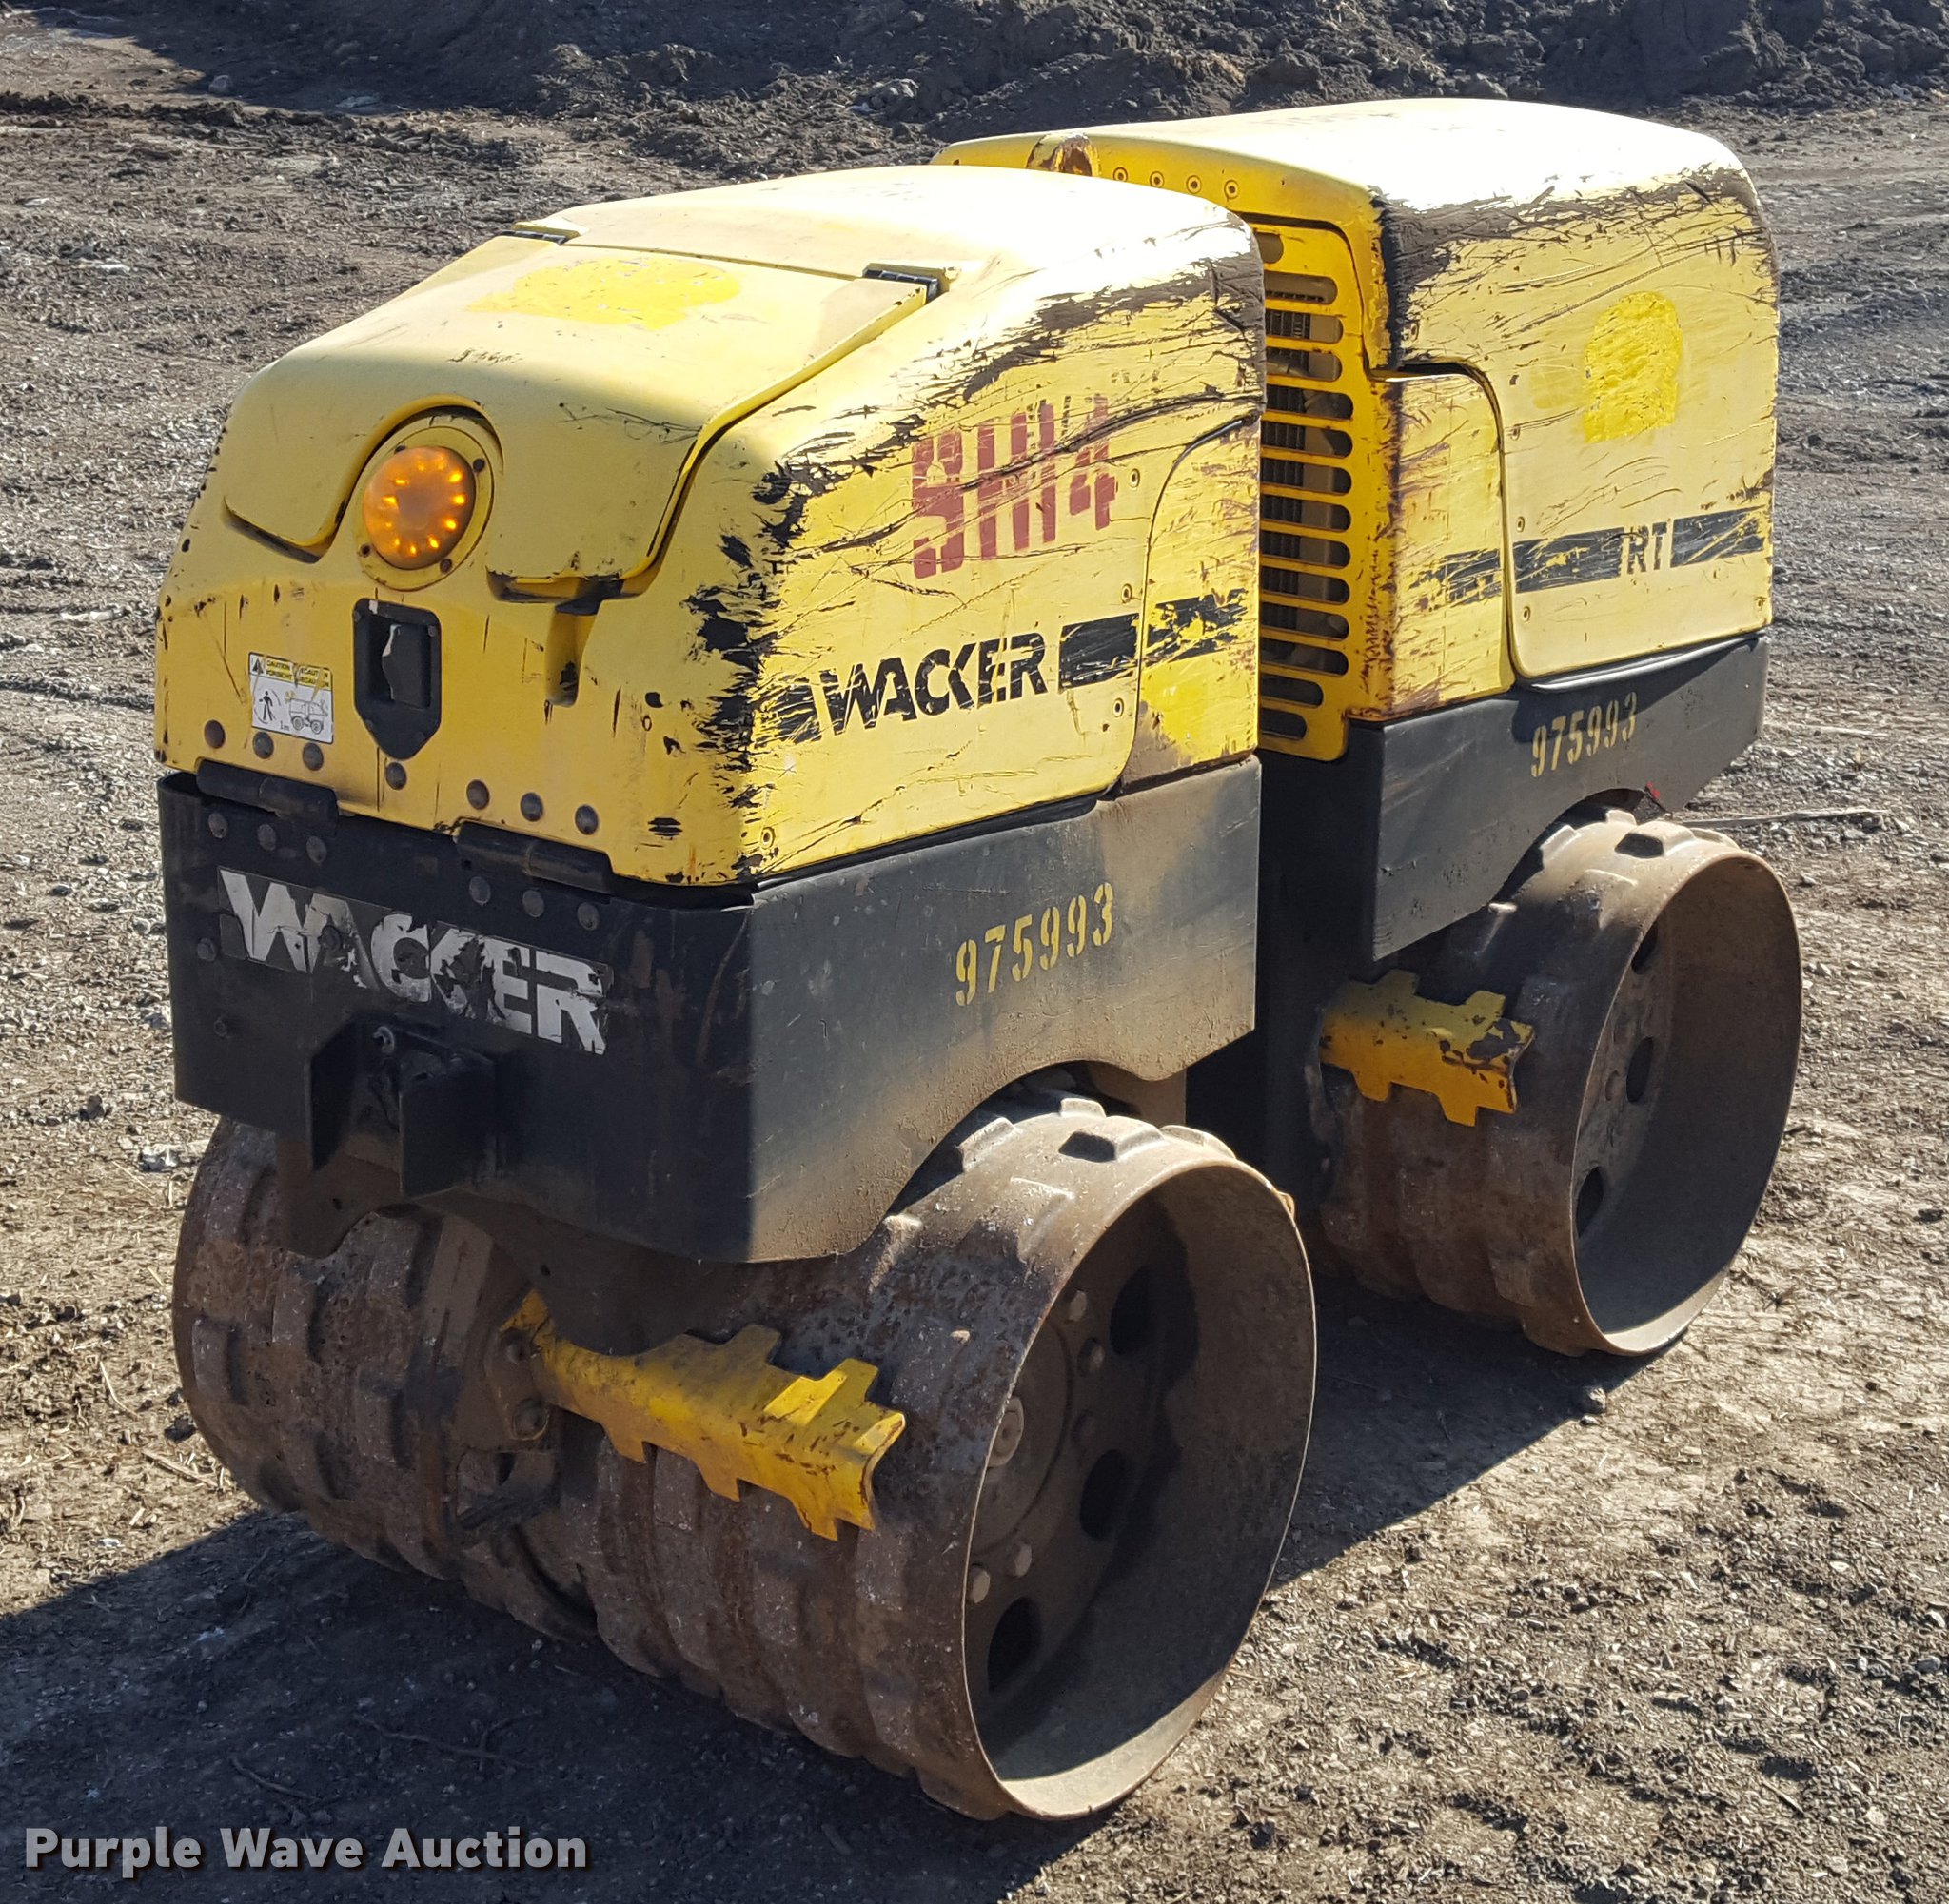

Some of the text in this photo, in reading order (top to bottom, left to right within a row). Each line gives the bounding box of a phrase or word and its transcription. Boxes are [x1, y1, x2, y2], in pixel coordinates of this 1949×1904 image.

[1626, 521, 1667, 575] RT
[819, 632, 1048, 736] WACKER
[1531, 691, 1638, 778] 975993
[219, 869, 606, 1055] WACKER
[955, 882, 1113, 1007] 975993
